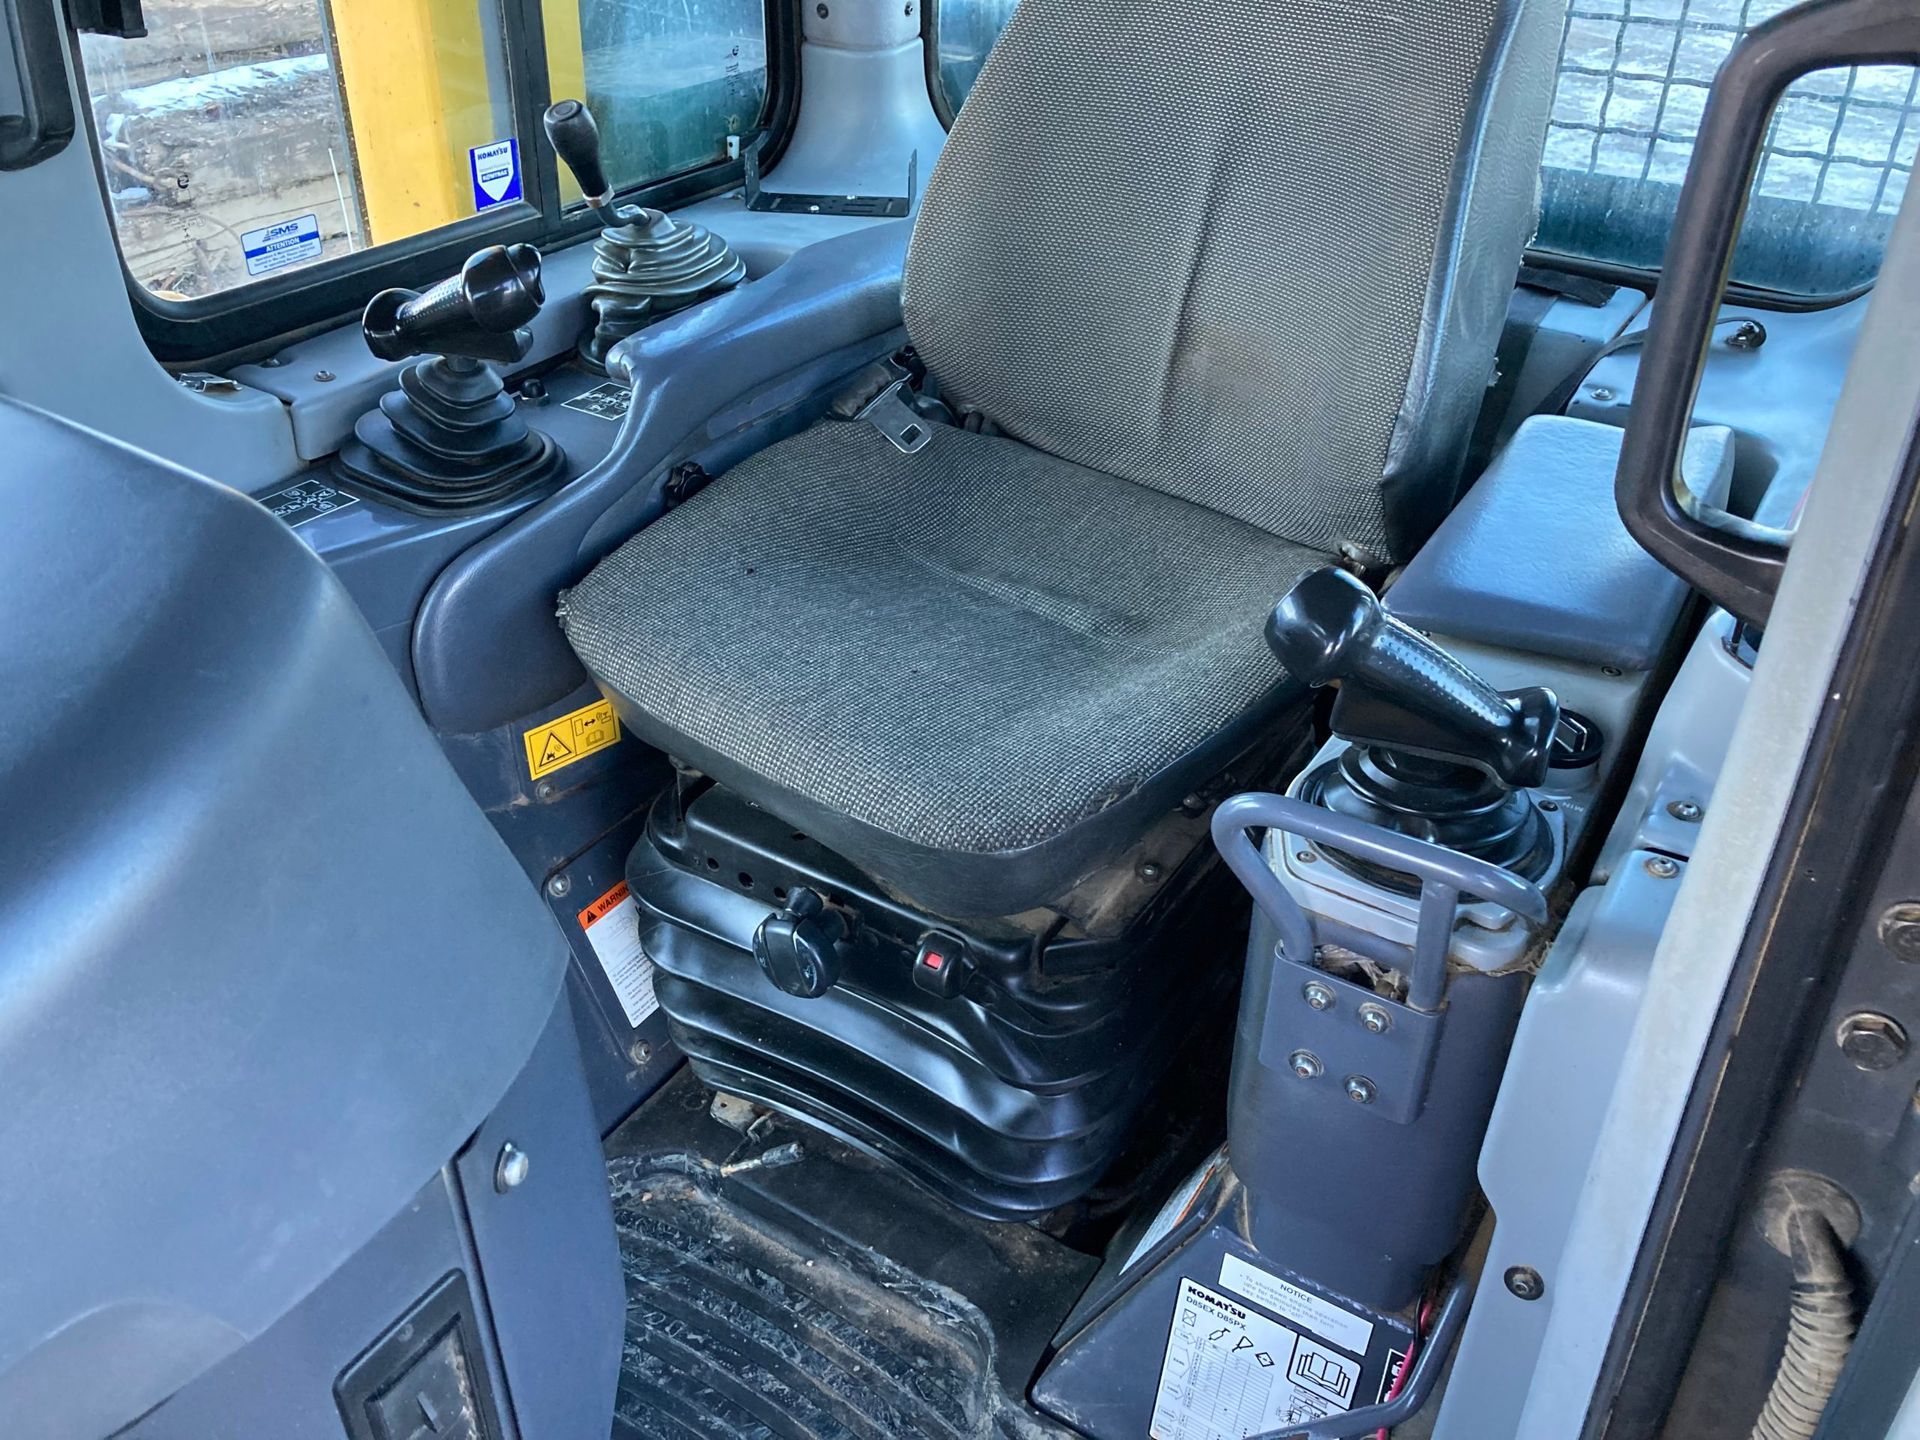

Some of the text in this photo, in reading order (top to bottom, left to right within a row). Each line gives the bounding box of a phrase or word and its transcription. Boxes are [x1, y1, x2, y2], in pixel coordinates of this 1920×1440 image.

[477, 147, 508, 160] KOMATSU
[270, 222, 299, 237] SMS
[266, 237, 300, 252] ATTENTION
[597, 885, 629, 912] WARNIN
[1187, 1285, 1247, 1320] KOMATSU
[1280, 1283, 1312, 1304] NOTICE
[1186, 1296, 1247, 1331] D85EX D85PX
